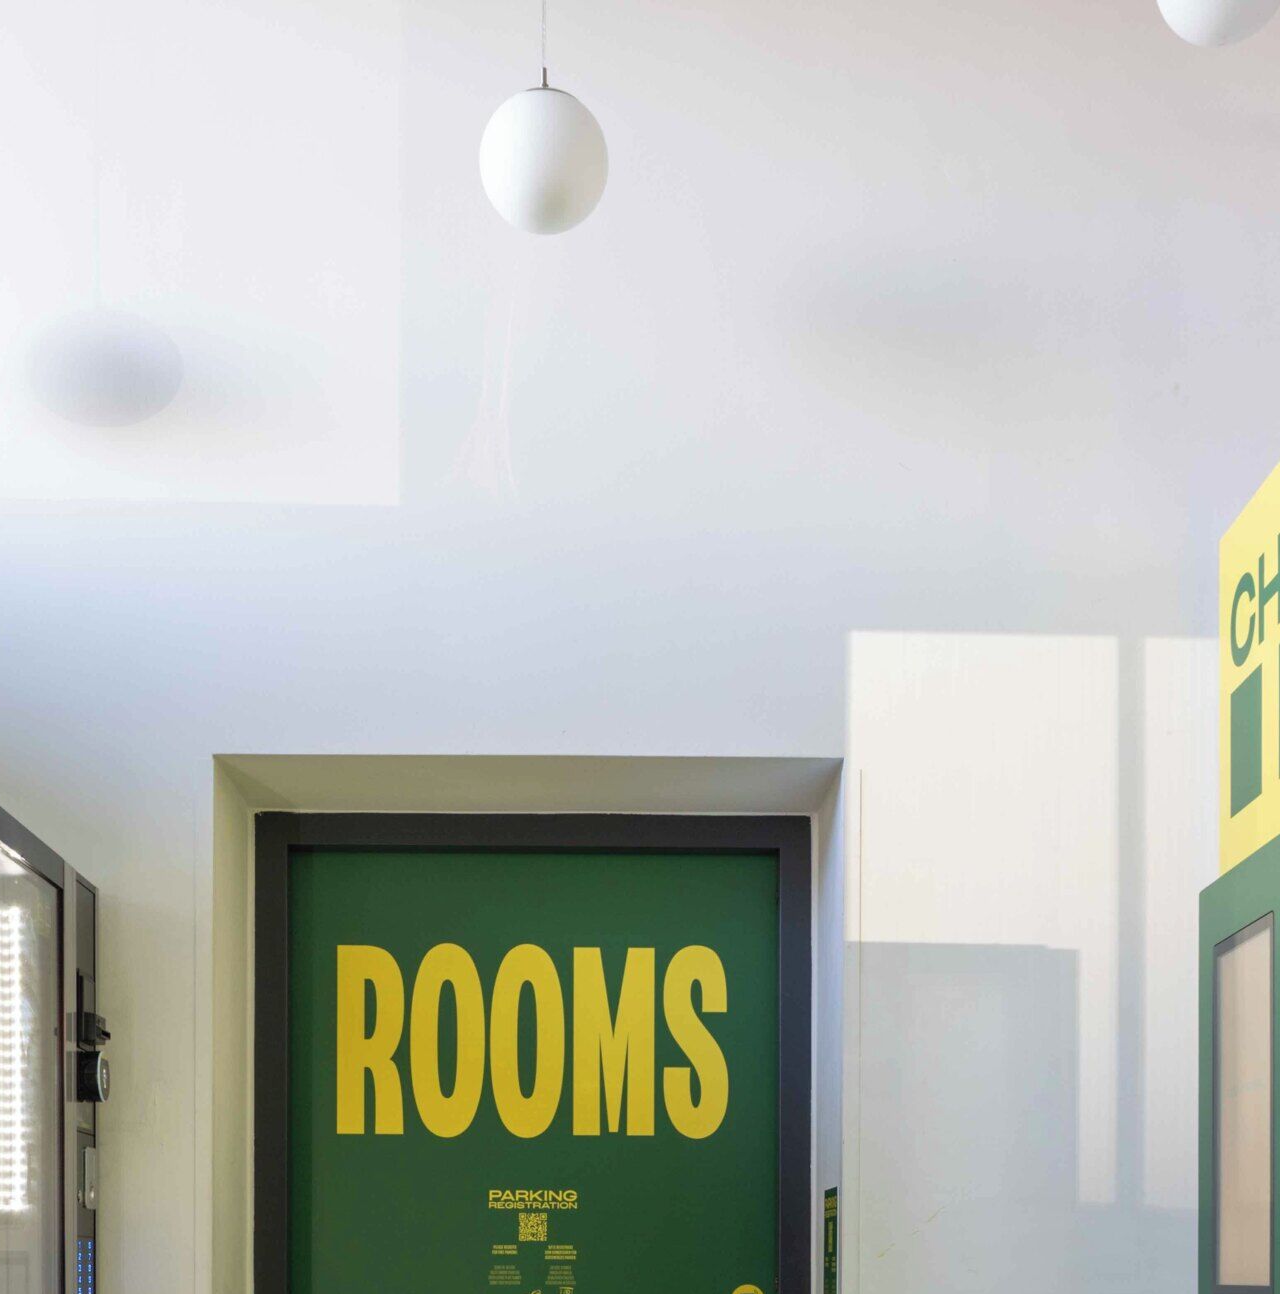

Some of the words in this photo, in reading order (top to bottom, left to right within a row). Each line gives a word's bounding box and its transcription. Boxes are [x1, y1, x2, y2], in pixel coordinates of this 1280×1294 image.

[336, 943, 729, 1139] ROOMS
[488, 1190, 577, 1201] PARKING
[488, 1201, 577, 1209] REGISTRATION
